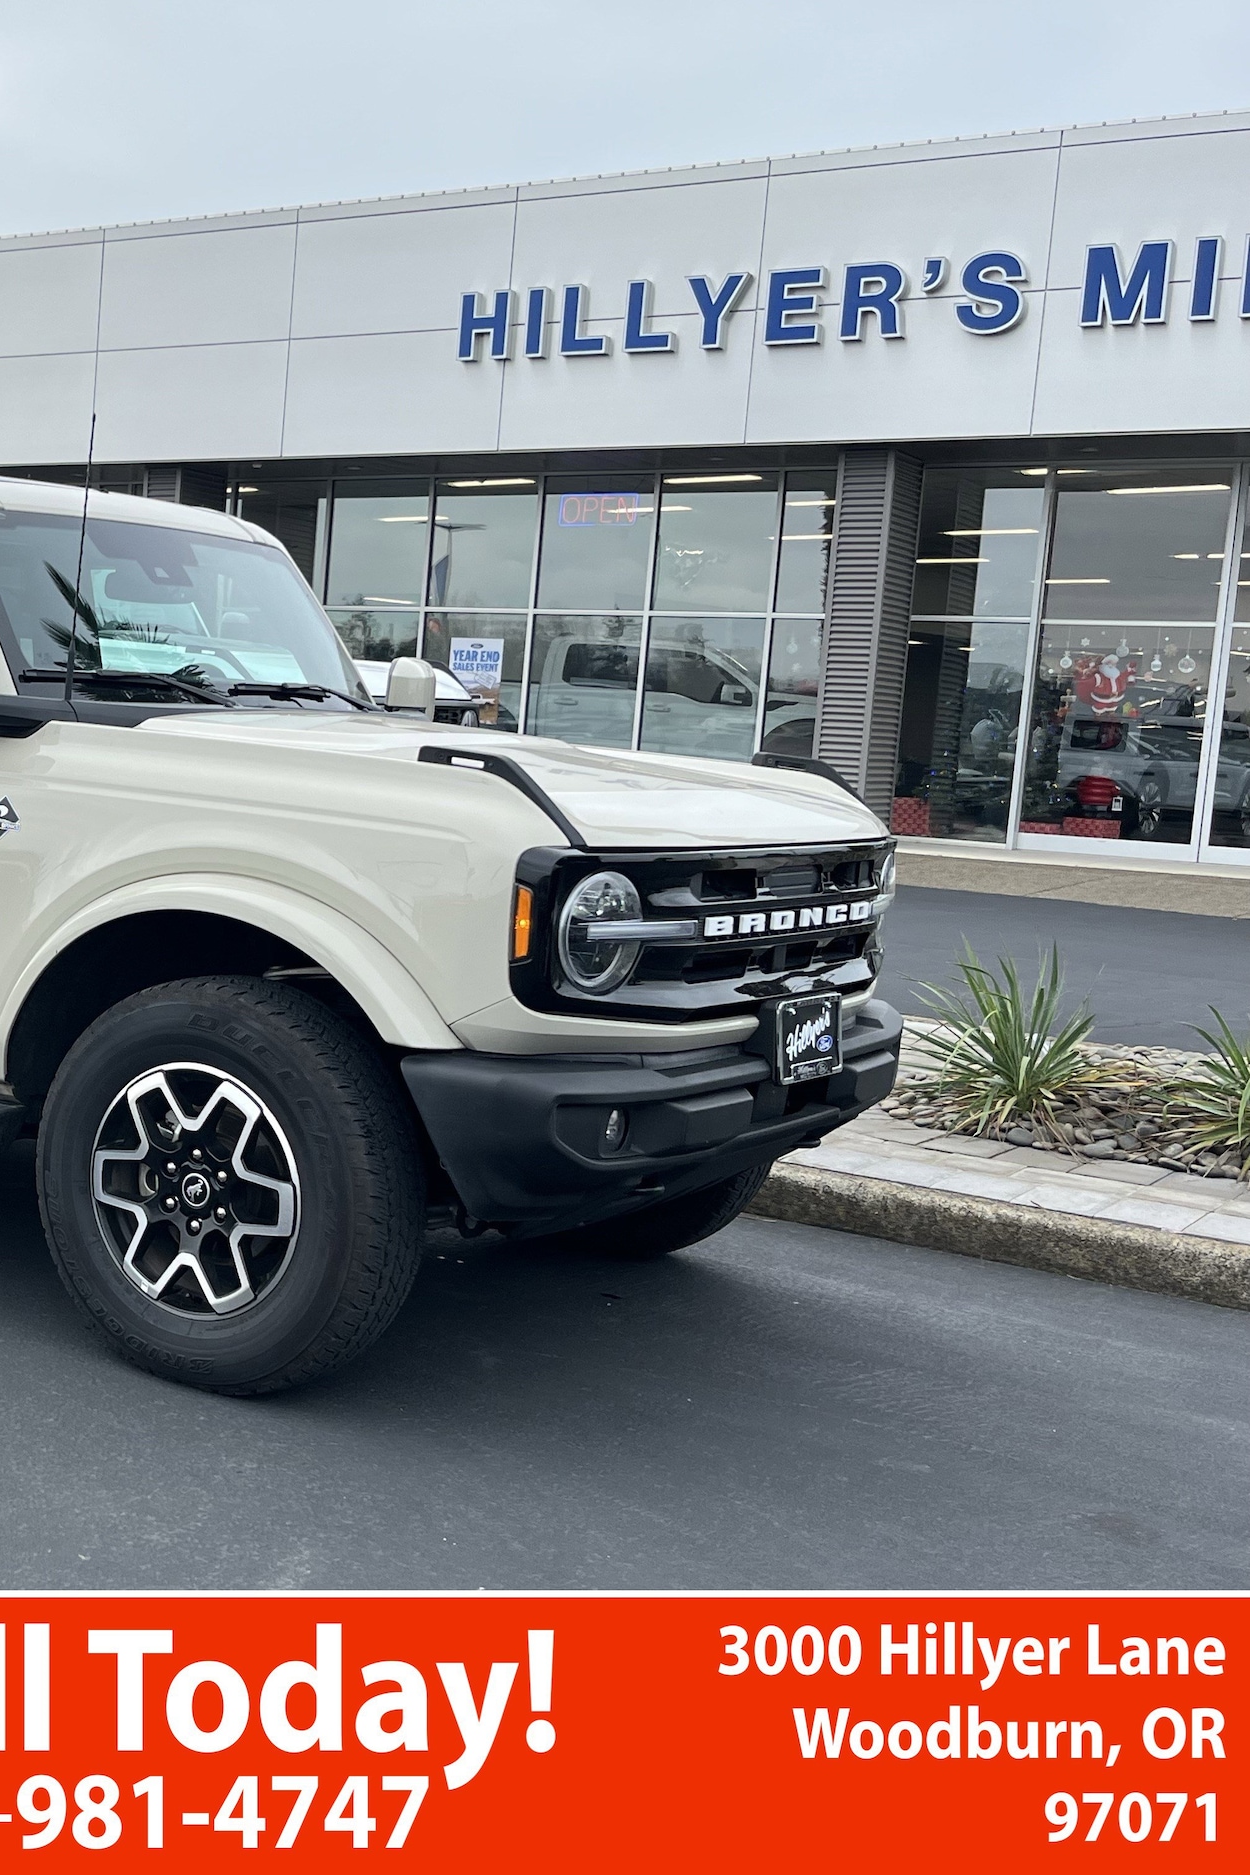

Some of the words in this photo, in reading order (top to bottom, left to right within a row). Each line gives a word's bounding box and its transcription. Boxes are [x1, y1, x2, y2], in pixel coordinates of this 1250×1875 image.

[457, 251, 1028, 361] HILLYER'S
[1078, 233, 1250, 327] MI
[562, 496, 636, 524] OPEN
[452, 662, 474, 671] SALES
[476, 663, 499, 672] EVENT
[453, 650, 478, 662] YEAR
[480, 651, 500, 663] END
[704, 901, 870, 937] BRONCO
[786, 1007, 830, 1061] Hillyer's
